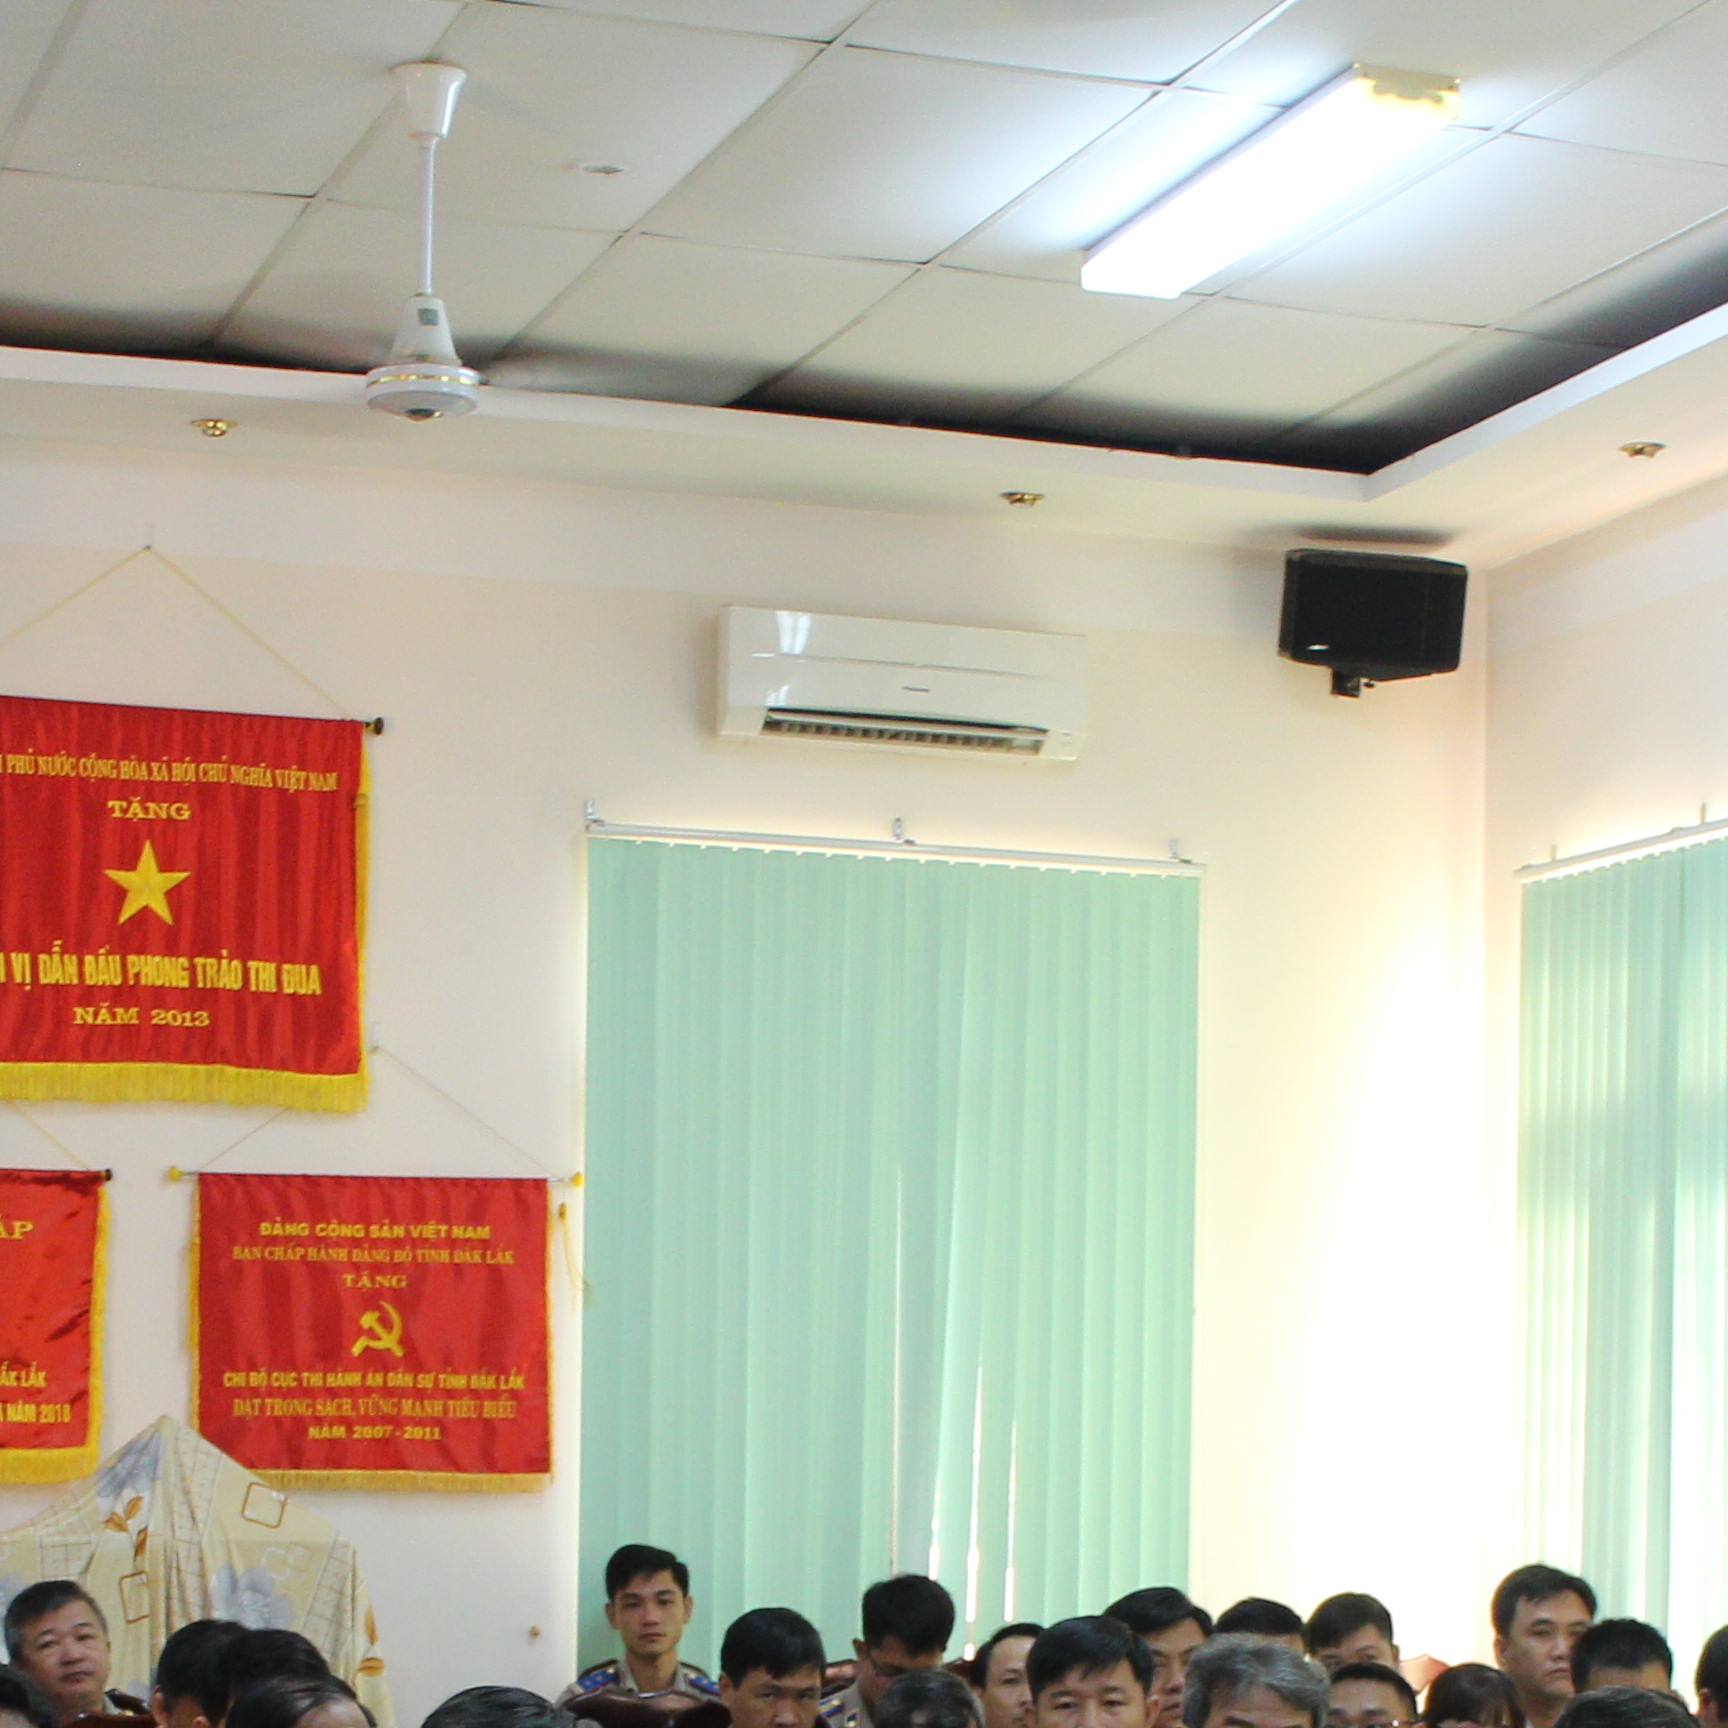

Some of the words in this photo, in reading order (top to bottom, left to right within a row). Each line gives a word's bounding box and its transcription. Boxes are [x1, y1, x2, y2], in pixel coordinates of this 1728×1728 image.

[107, 796, 192, 822] TẶNG
[73, 1002, 140, 1026] NĂM
[150, 1008, 211, 1028] 2013
[342, 1271, 408, 1292] TẶNG
